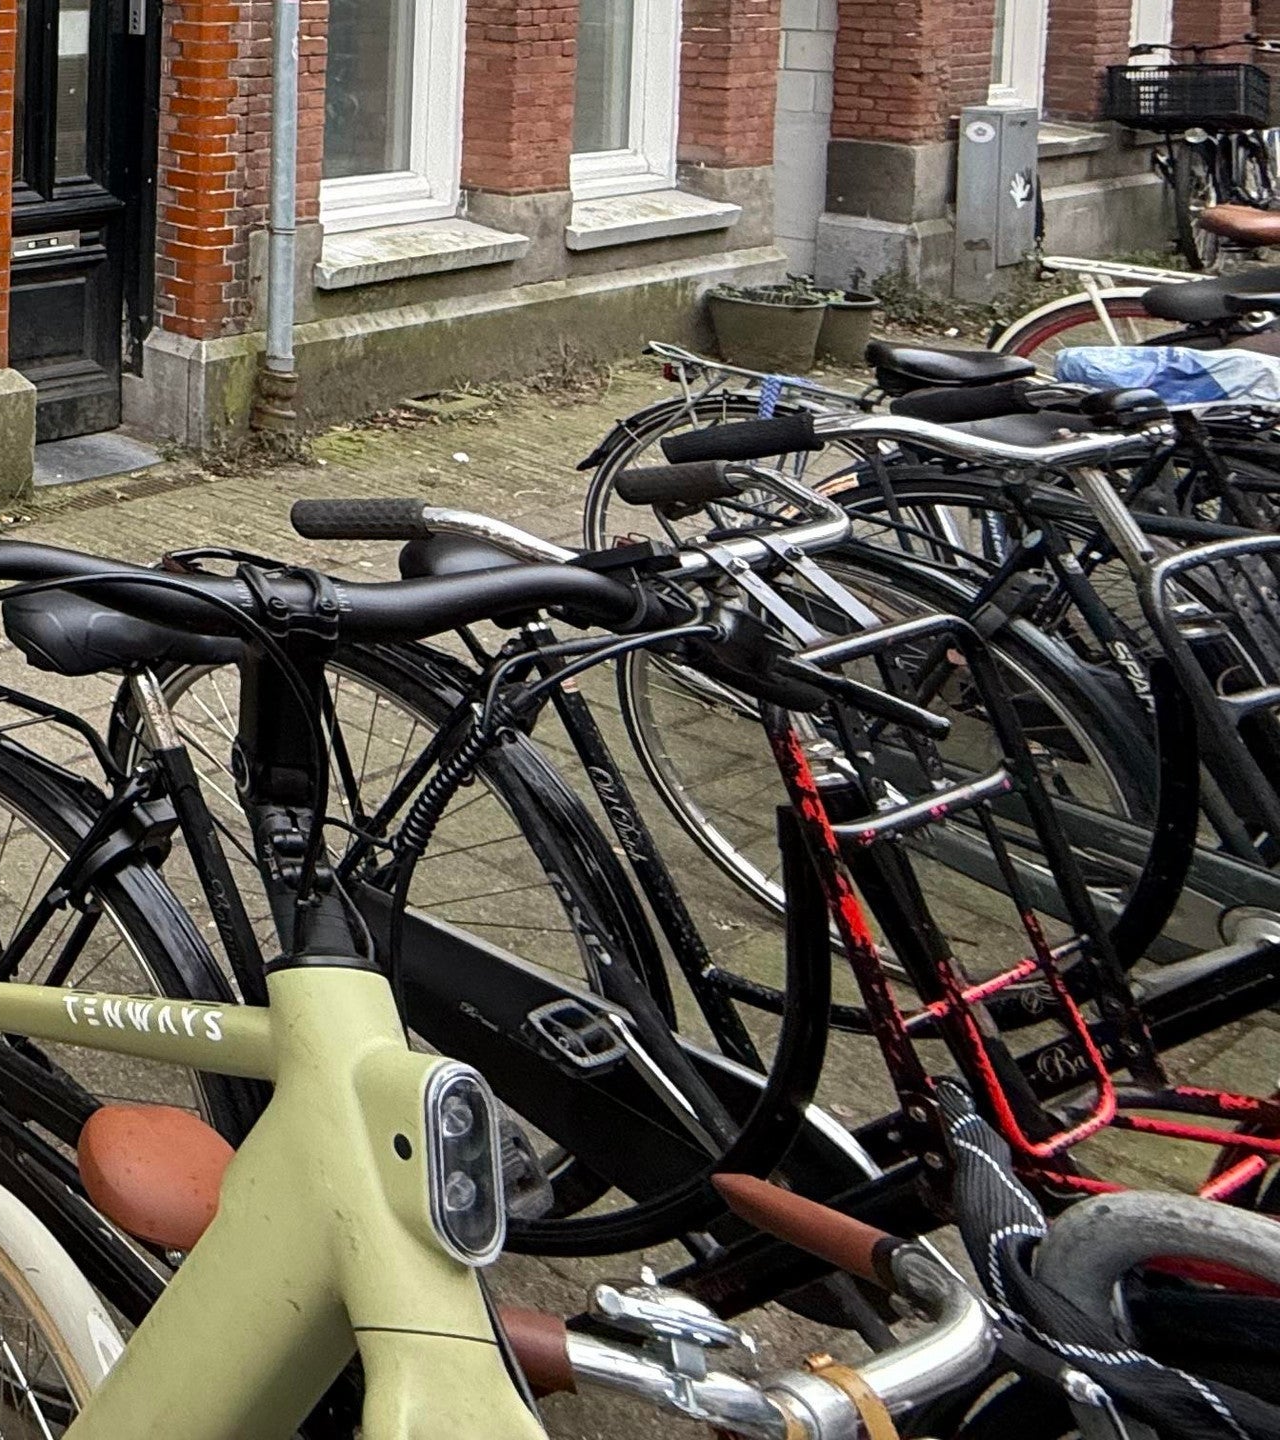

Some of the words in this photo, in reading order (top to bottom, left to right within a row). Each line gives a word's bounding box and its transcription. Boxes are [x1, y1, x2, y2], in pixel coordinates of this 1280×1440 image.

[588, 766, 620, 804] Old
[610, 806, 649, 862] Dutch
[62, 995, 224, 1042] TENWAYS
